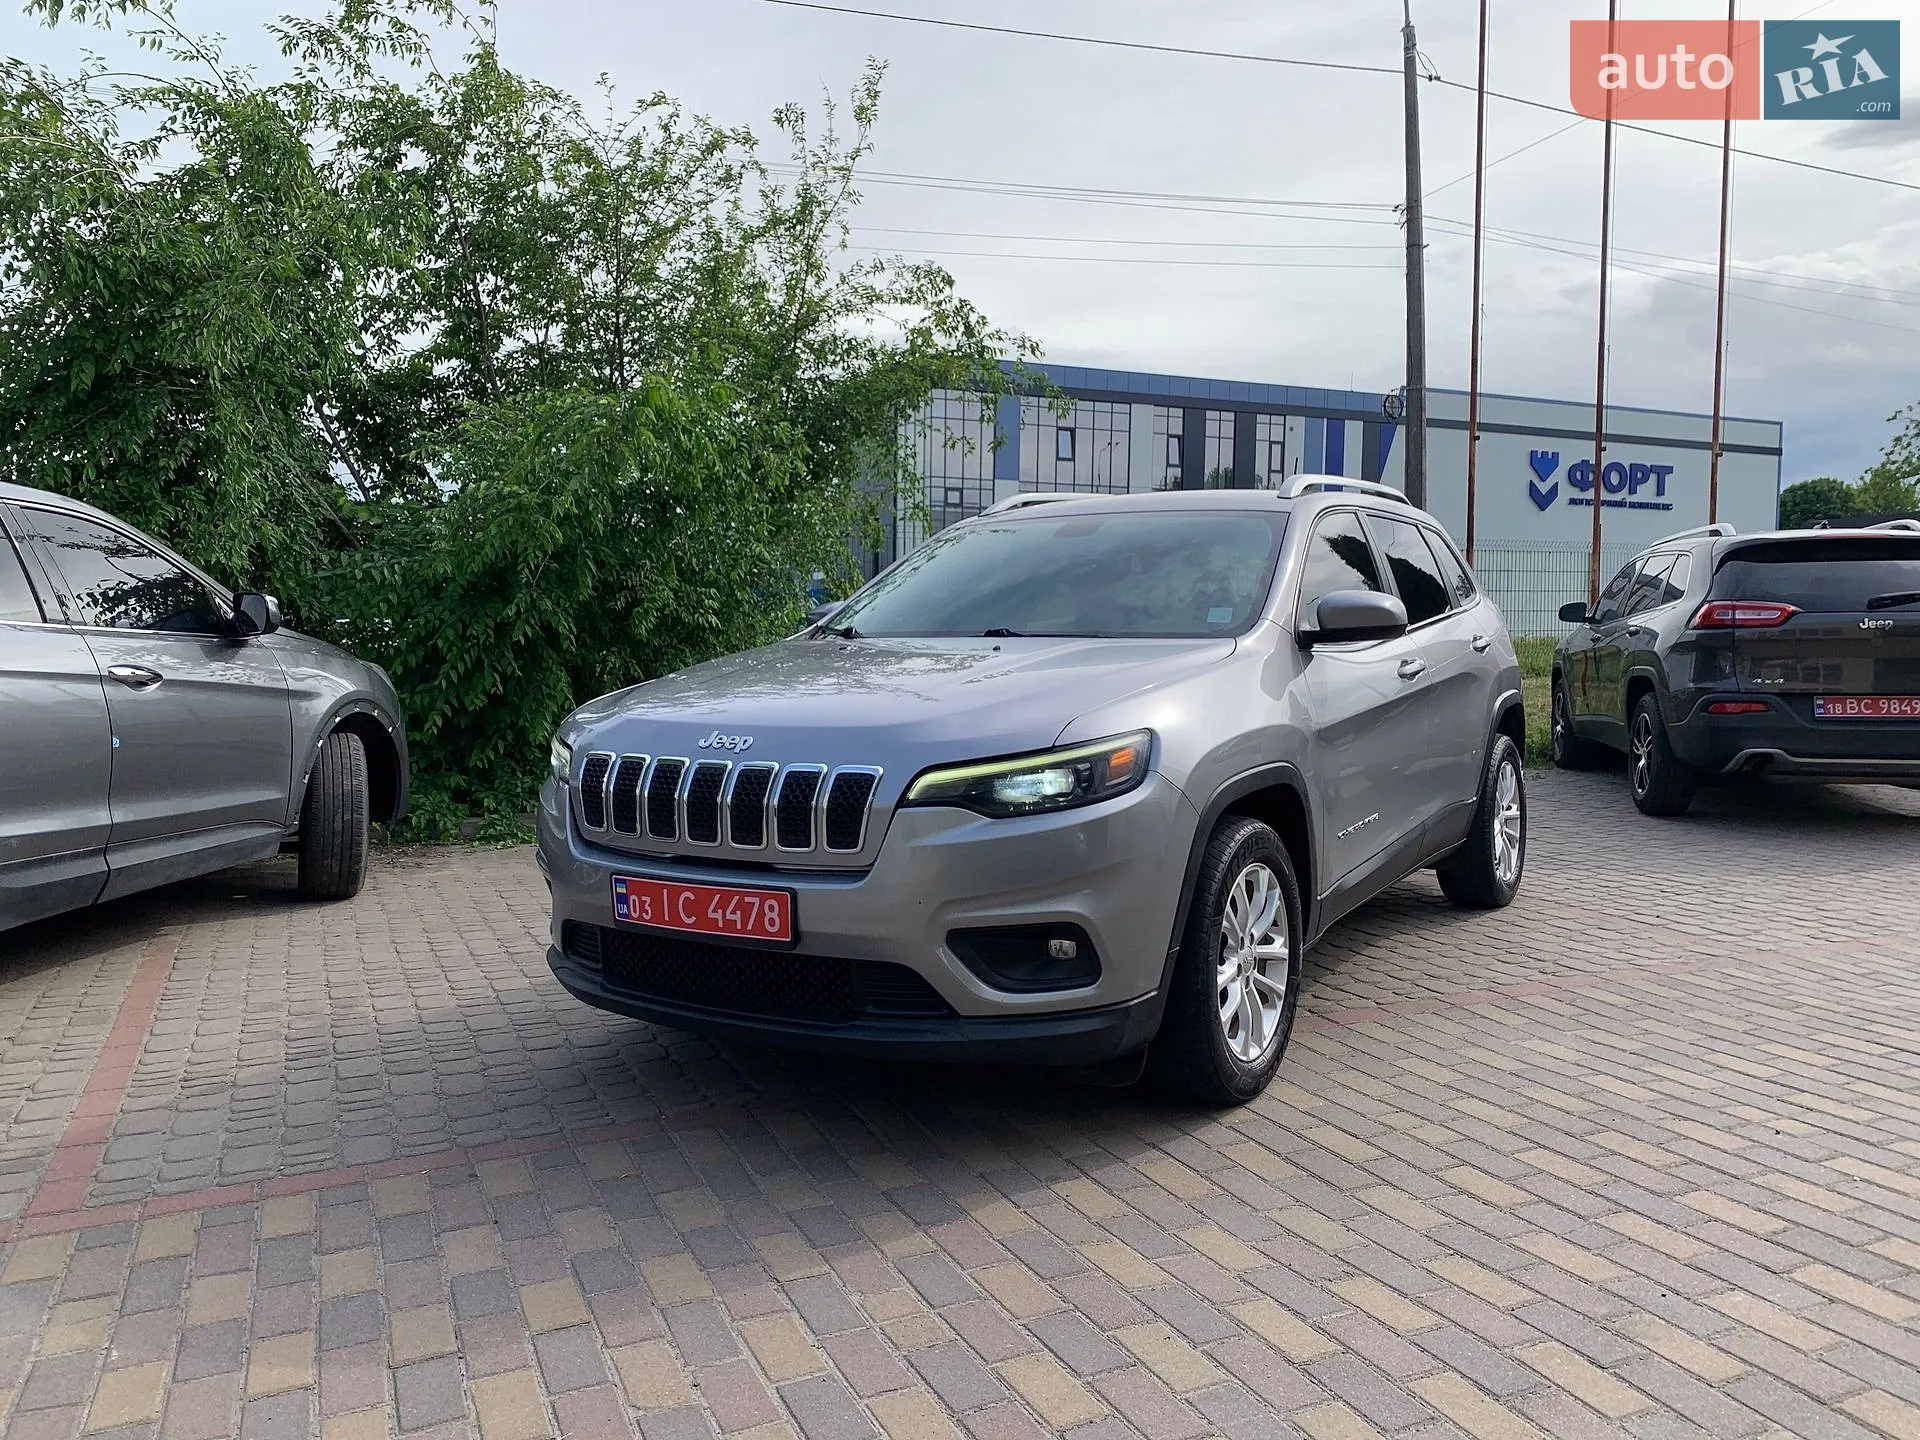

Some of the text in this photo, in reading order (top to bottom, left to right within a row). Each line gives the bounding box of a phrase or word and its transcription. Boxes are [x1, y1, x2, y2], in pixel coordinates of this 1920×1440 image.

[1568, 459, 1674, 497] ФОРТ
[1859, 617, 1894, 631] Jeep
[1827, 703, 1842, 714] 18
[1846, 699, 1873, 714] BC
[1879, 699, 1920, 714] 9849
[698, 730, 754, 753] Jeep
[617, 888, 781, 933] UA 03 IC 4478
